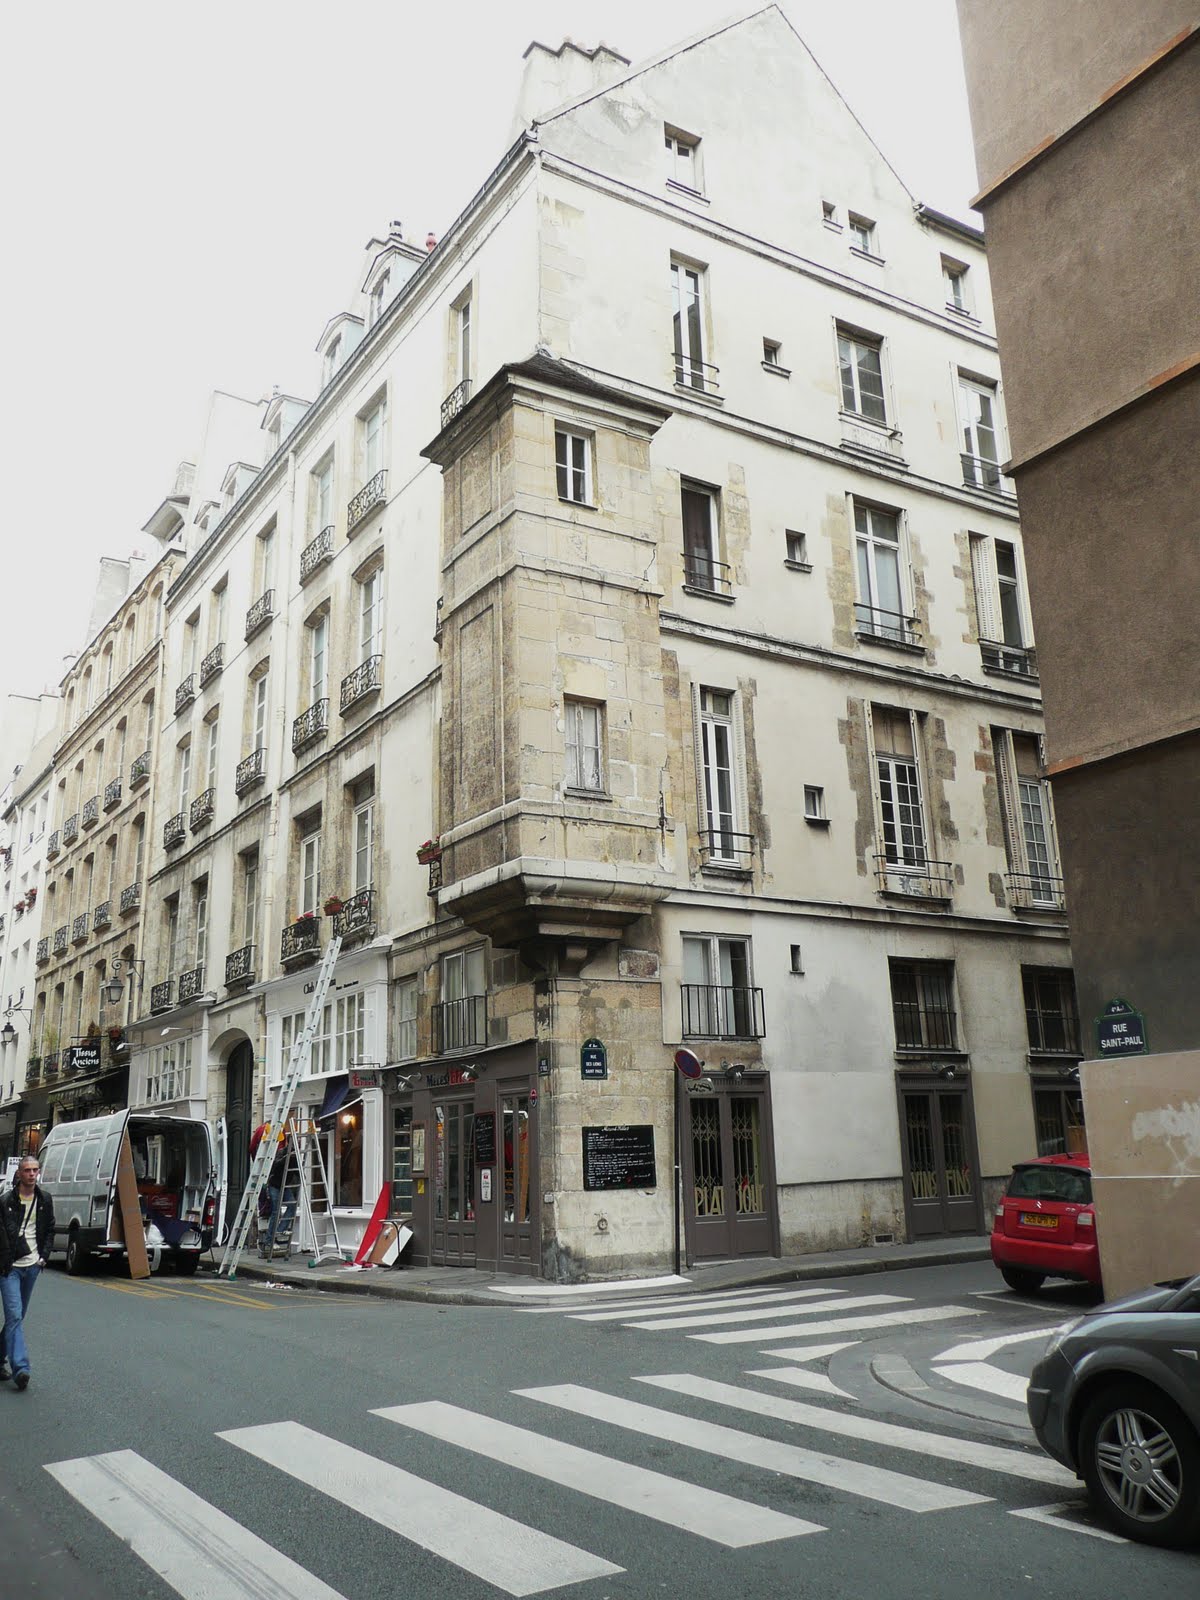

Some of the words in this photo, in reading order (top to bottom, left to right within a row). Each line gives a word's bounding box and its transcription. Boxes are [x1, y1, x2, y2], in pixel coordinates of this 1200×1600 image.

[1112, 1023, 1127, 1033] RUE
[1101, 1036, 1143, 1048] SAINT-PAUL
[72, 1047, 97, 1057] Tissus
[71, 1057, 99, 1069] Anciens
[911, 1170, 938, 1199] VINS
[945, 1168, 971, 1197] FINS
